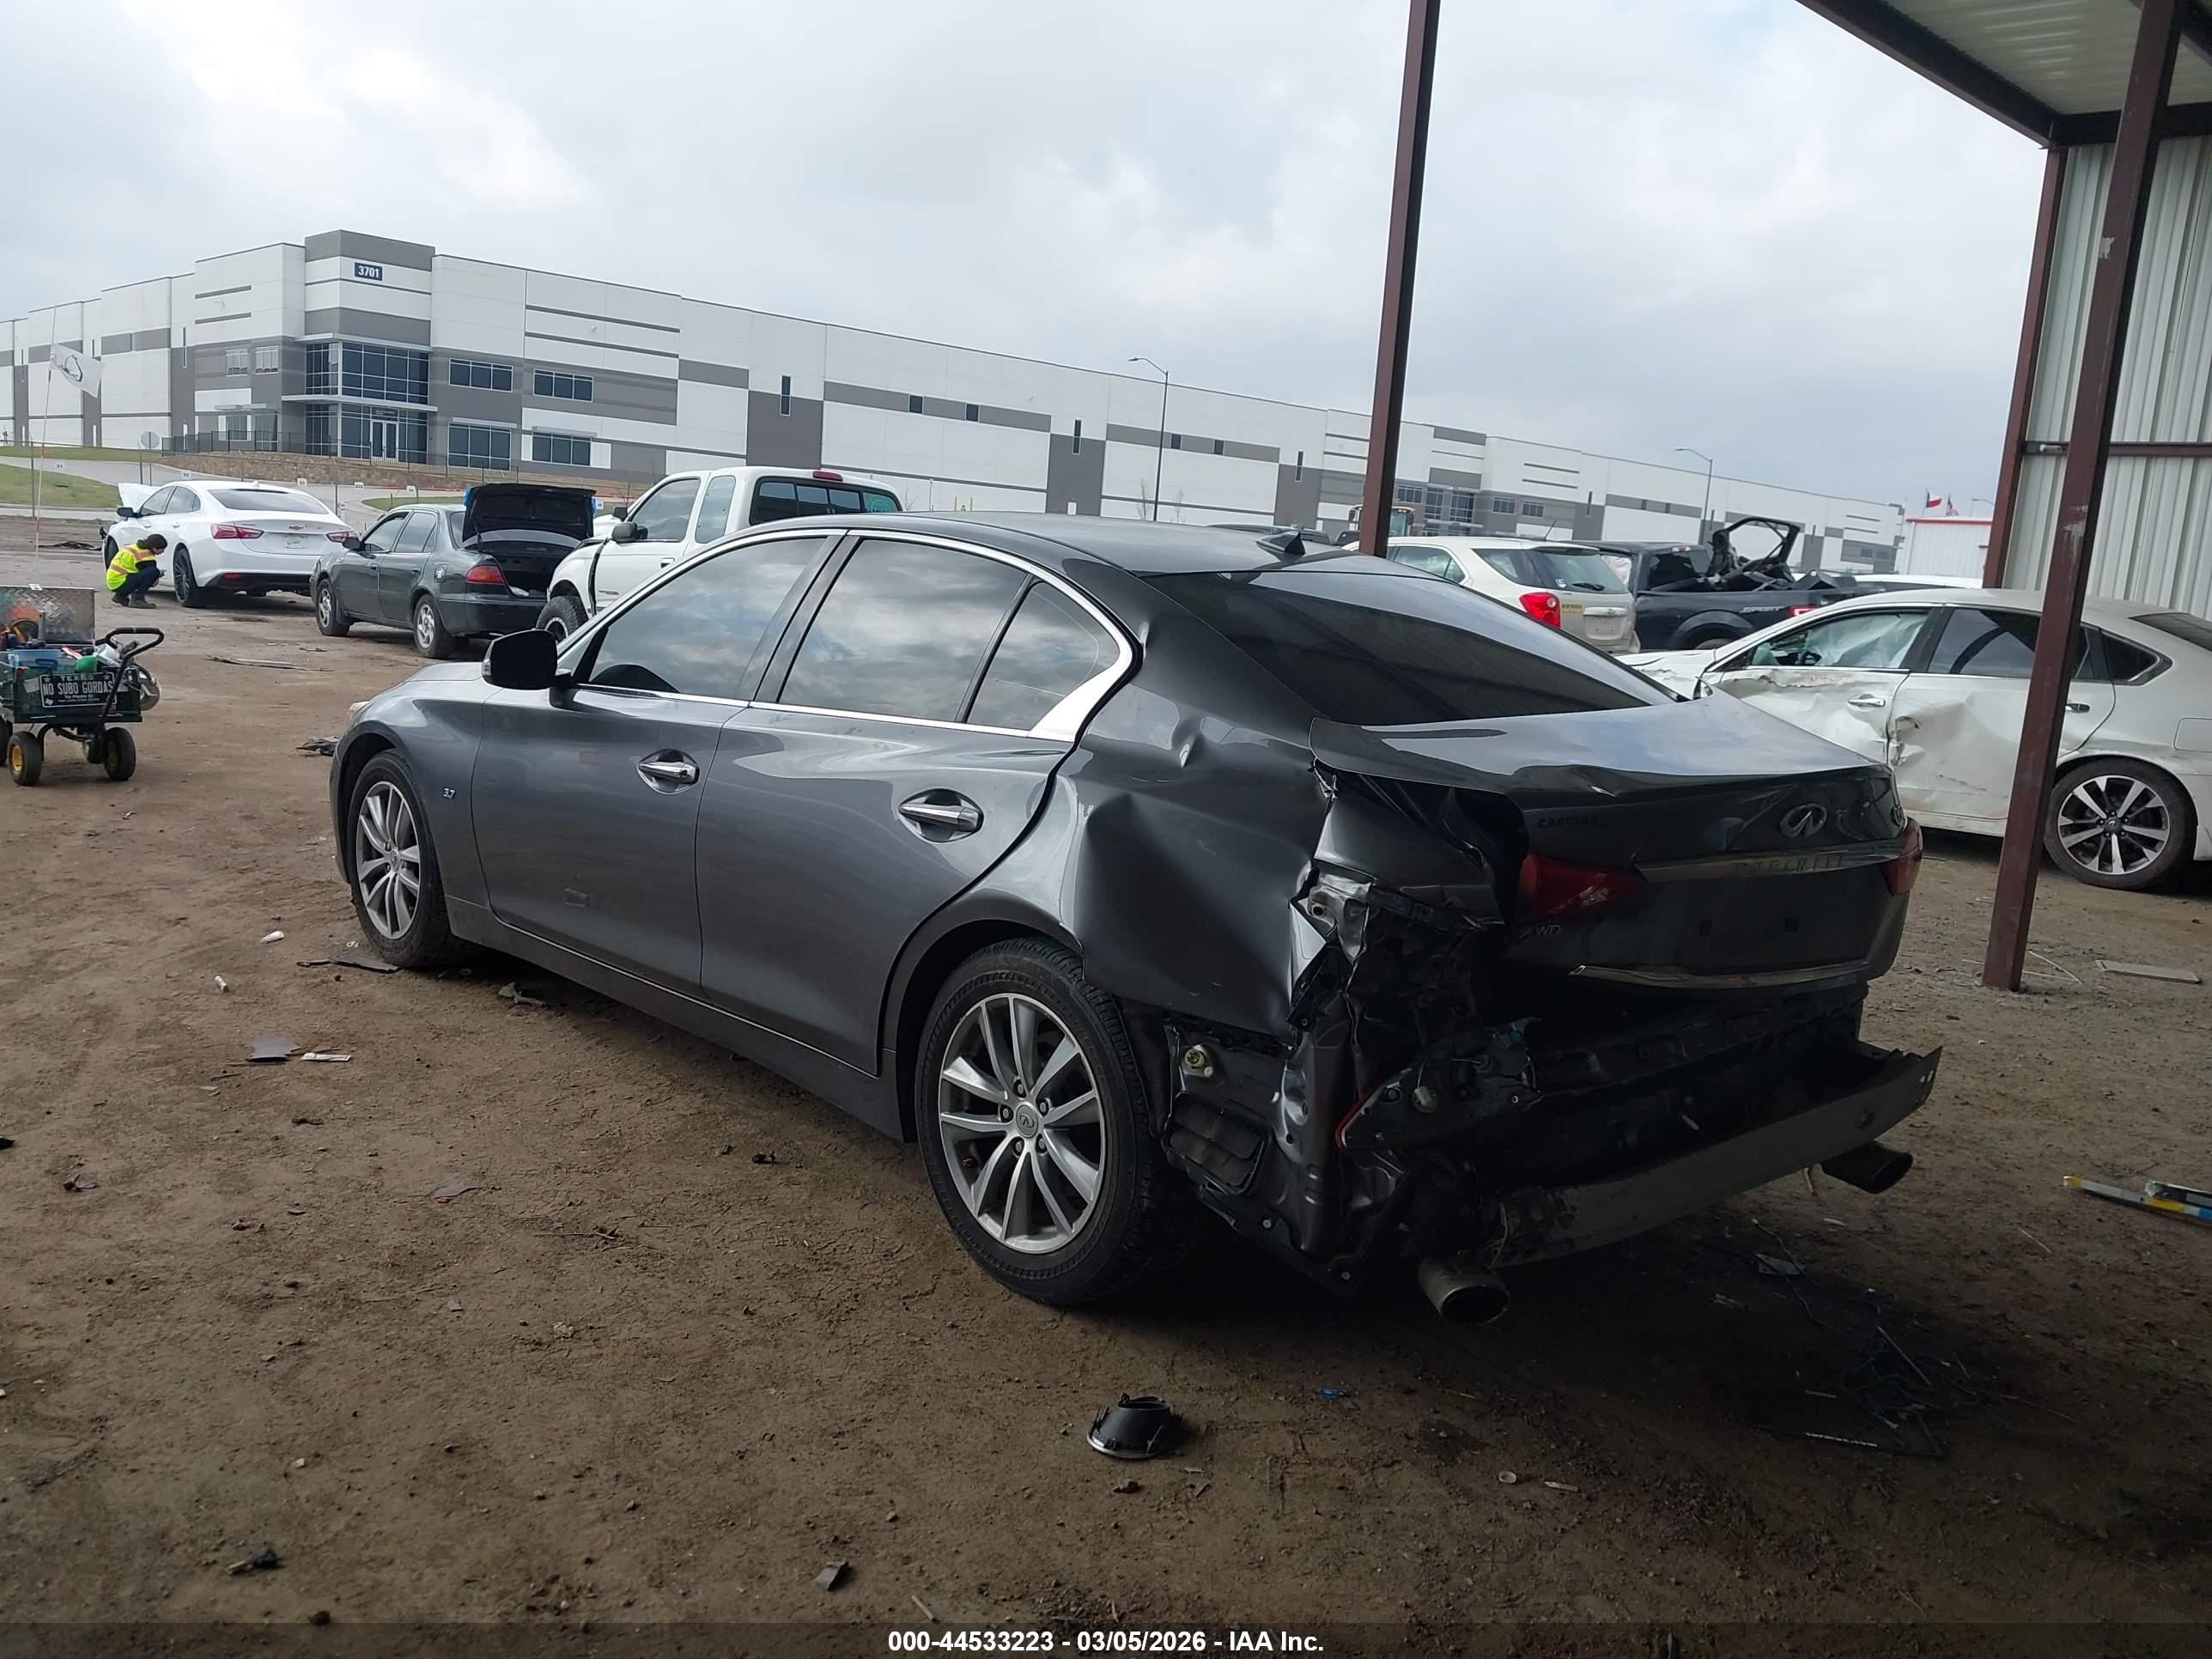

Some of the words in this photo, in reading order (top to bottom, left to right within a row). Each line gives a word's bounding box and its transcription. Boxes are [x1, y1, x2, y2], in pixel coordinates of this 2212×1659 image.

[358, 265, 380, 278] 3701
[1739, 605, 1785, 614] SPORT
[43, 683, 54, 696] NO
[58, 682, 79, 695] SUBO
[82, 681, 113, 694] GORDAS
[443, 787, 455, 799] 3.7
